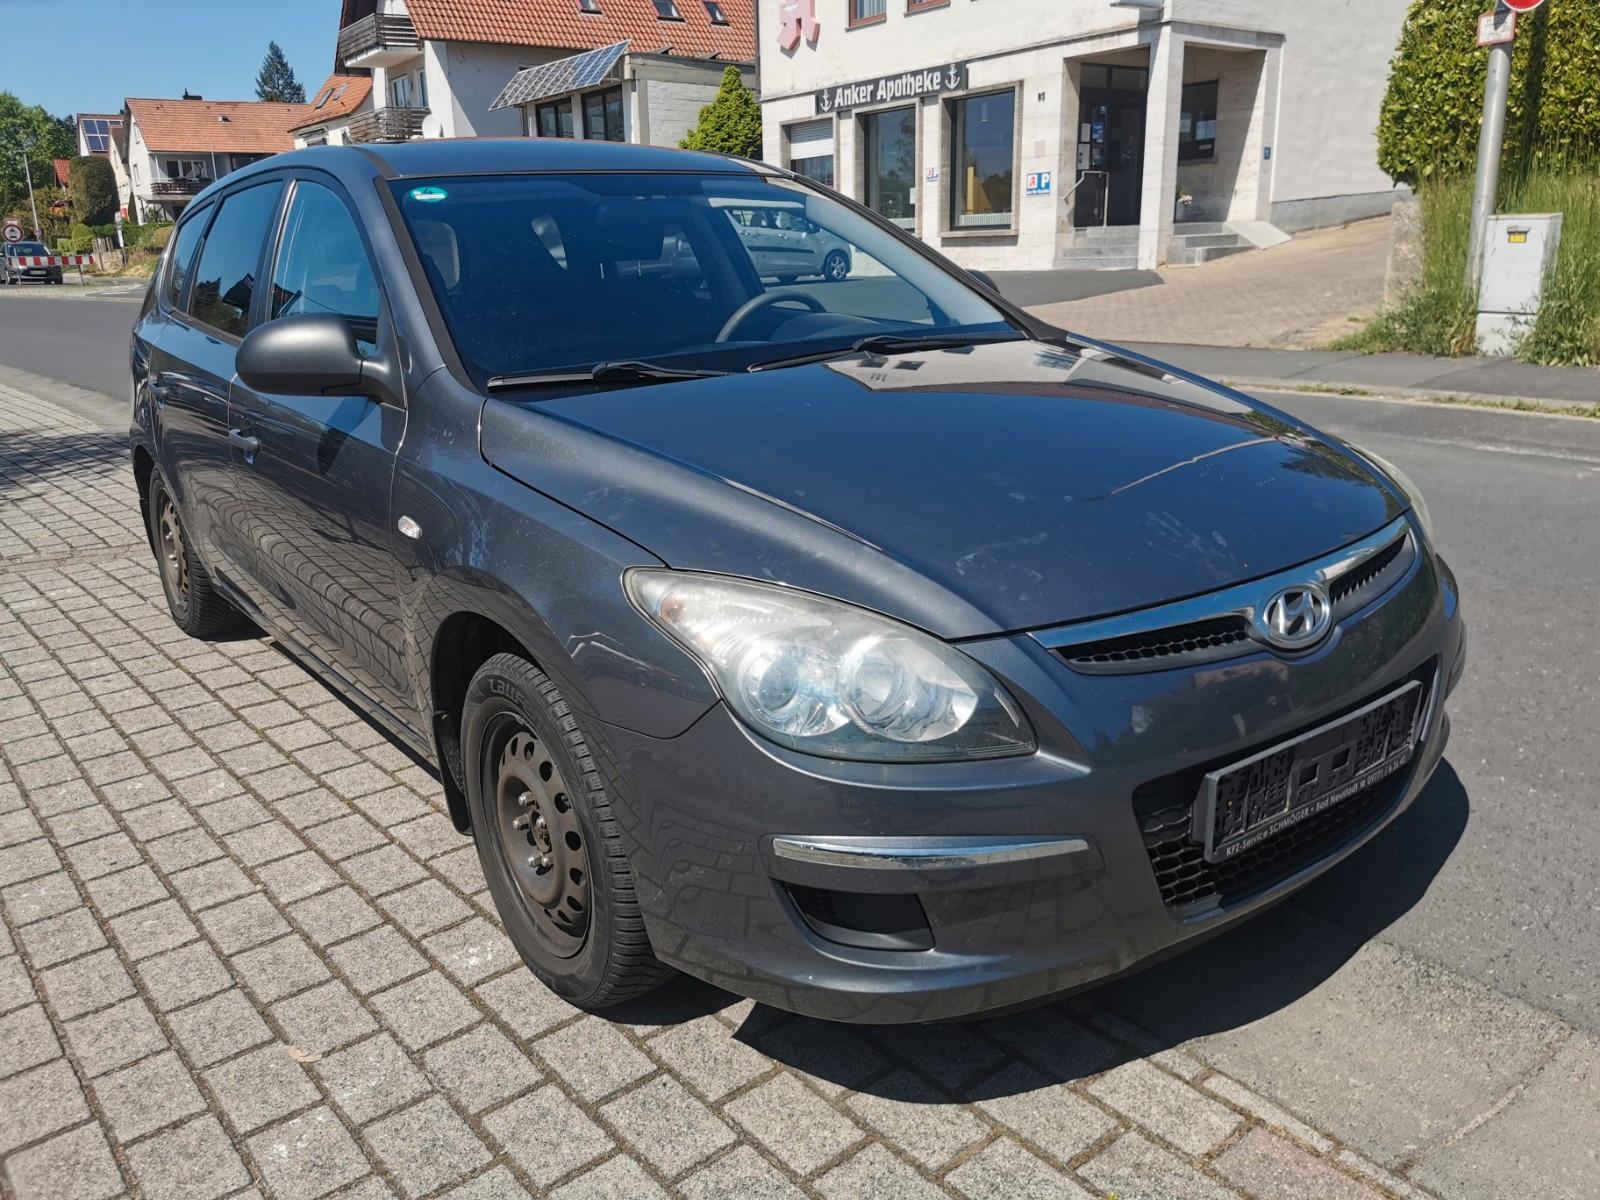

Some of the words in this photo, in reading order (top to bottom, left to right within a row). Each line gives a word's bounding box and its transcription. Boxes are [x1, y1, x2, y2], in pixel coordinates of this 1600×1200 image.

[834, 83, 874, 108] Anker
[876, 70, 941, 102] Apotheke
[1316, 796, 1329, 812] Bad
[1330, 783, 1358, 804] Neustadt
